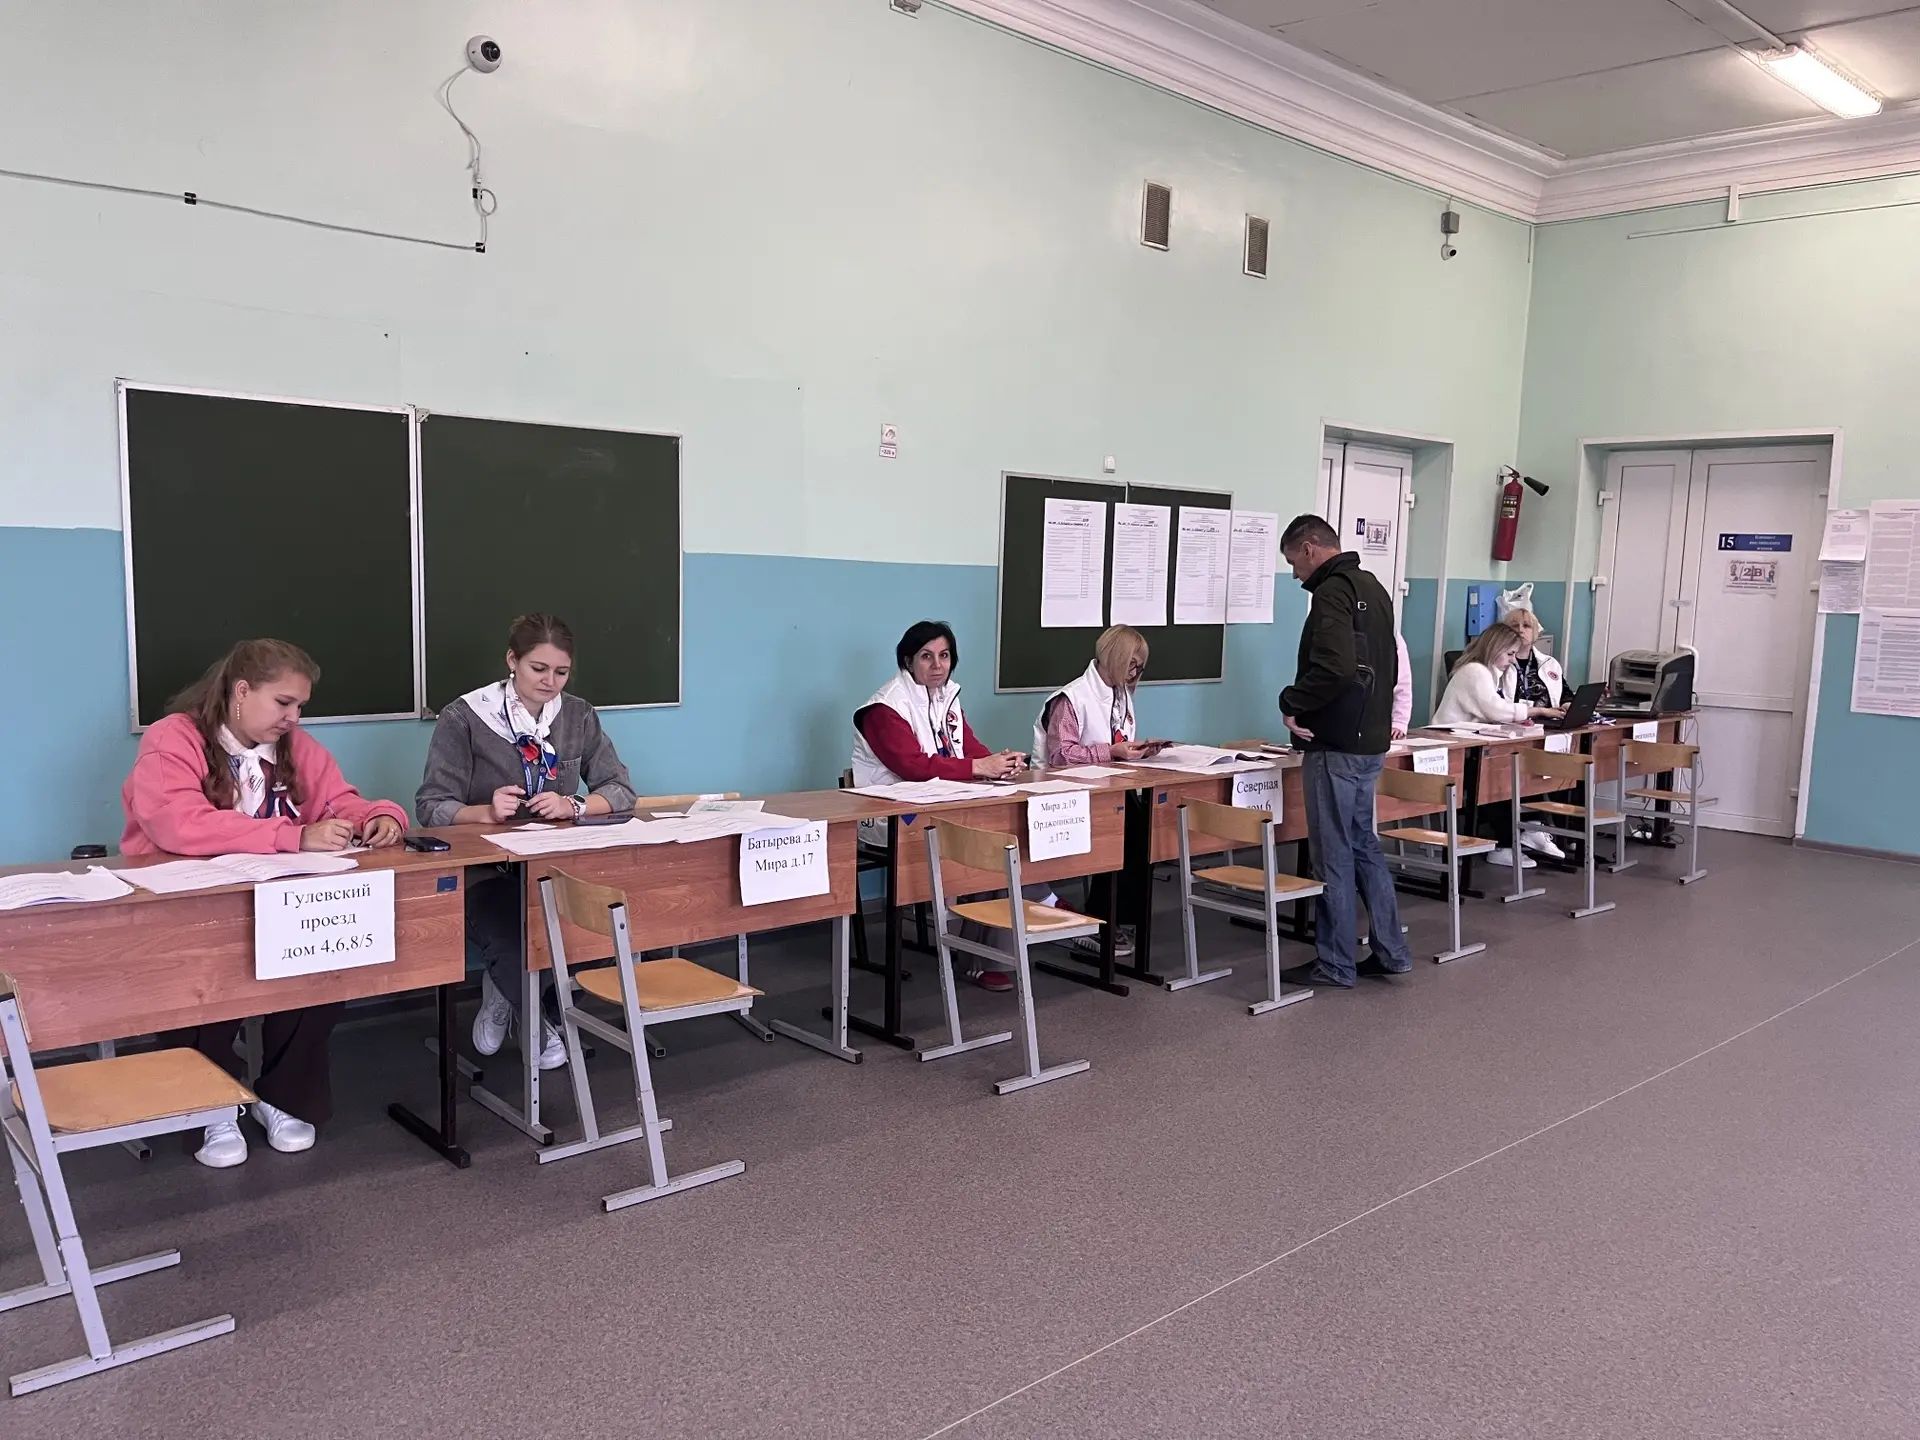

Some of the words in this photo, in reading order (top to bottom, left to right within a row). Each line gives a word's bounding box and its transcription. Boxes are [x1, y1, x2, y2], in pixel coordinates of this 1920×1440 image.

[1358, 521, 1365, 532] 16
[1721, 536, 1734, 548] 15
[1236, 780, 1278, 794] Северная
[1041, 802, 1060, 812] Мира
[748, 834, 801, 850] Батырева
[804, 829, 820, 844] д.3
[755, 859, 788, 872] Мира
[791, 852, 814, 868] д.17
[283, 884, 371, 909] Гулевский
[301, 913, 357, 932] проезд
[282, 945, 315, 960] дом
[320, 933, 373, 955] 4,6,8/5
